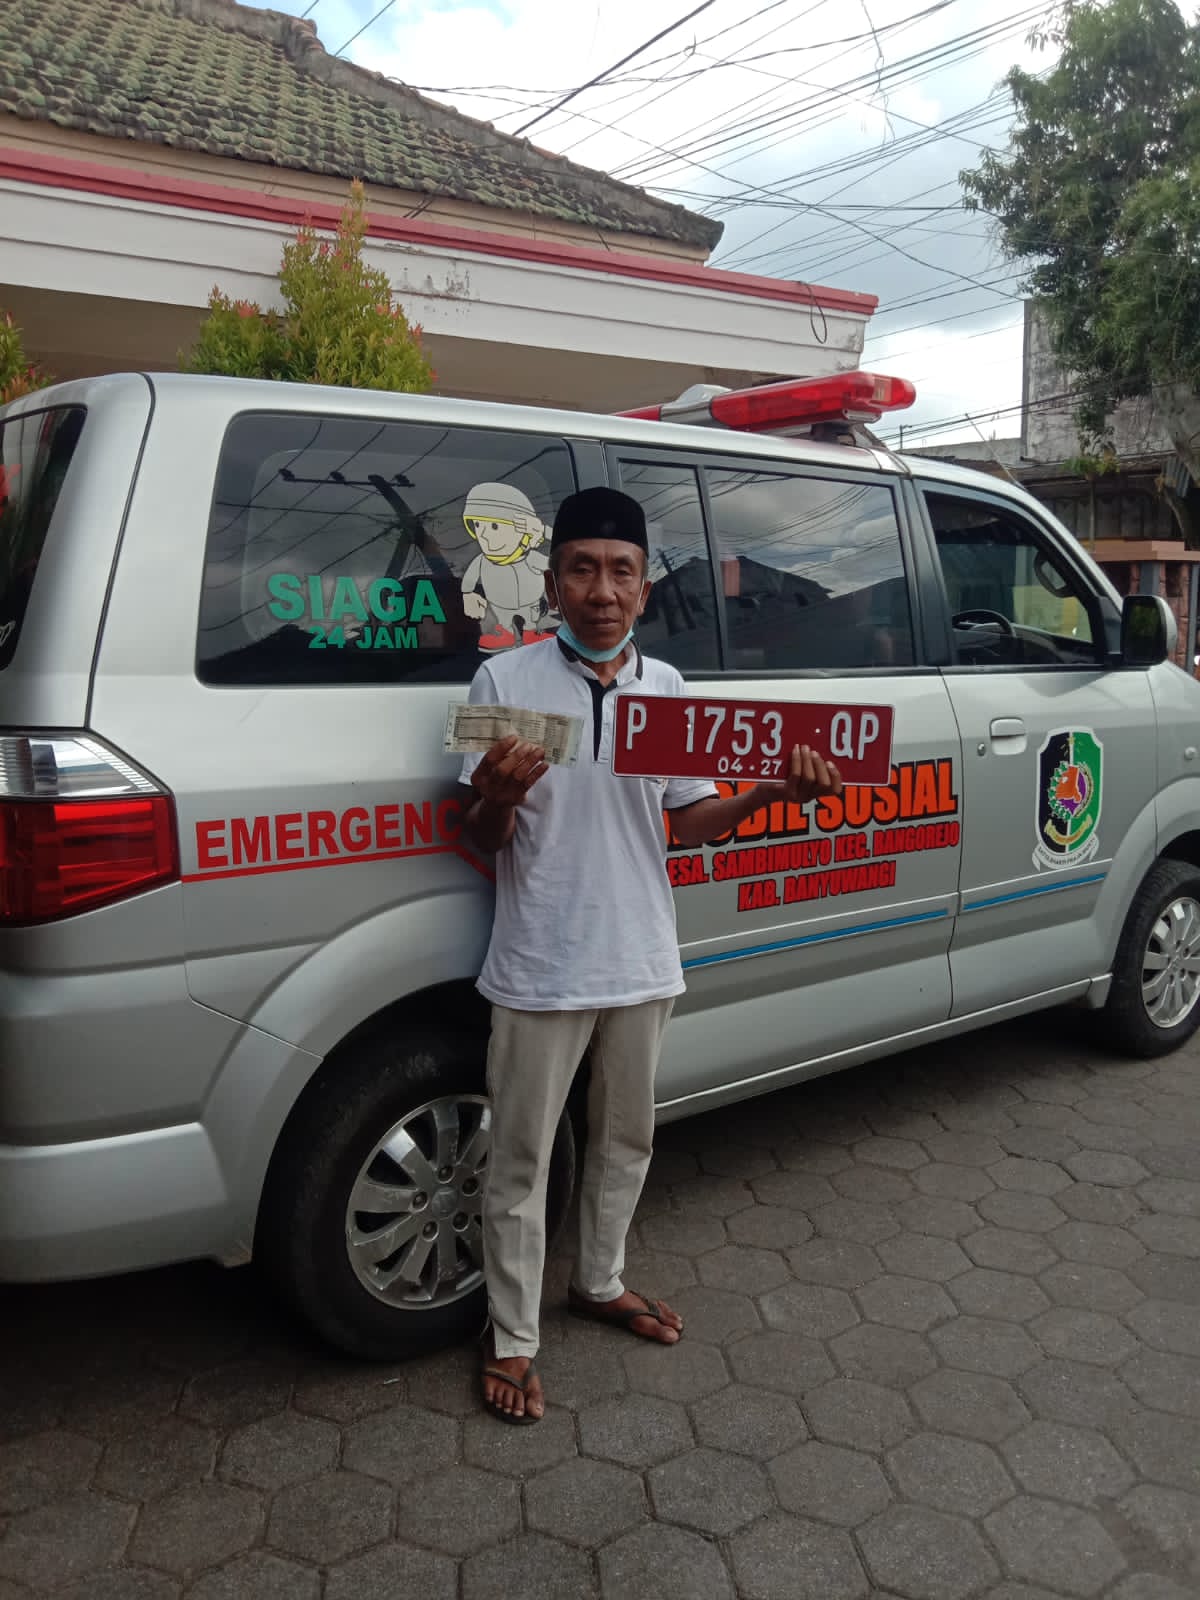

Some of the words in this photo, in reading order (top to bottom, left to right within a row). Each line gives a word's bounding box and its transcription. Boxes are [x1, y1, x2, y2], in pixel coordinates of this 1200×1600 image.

[266, 573, 447, 623] SIAGA
[308, 626, 346, 649] 24
[356, 627, 419, 650] JAM
[625, 702, 648, 751] P
[683, 705, 784, 757] 1753
[829, 711, 880, 761] QP
[814, 757, 958, 832] SOSIAL
[195, 799, 470, 869] EMERGENC
[666, 853, 710, 888] ESA.
[712, 837, 833, 882] SAMBIMULYO
[833, 831, 871, 863] KEC.
[737, 878, 781, 912] KAB.
[783, 860, 896, 904] BANYUWANGI
